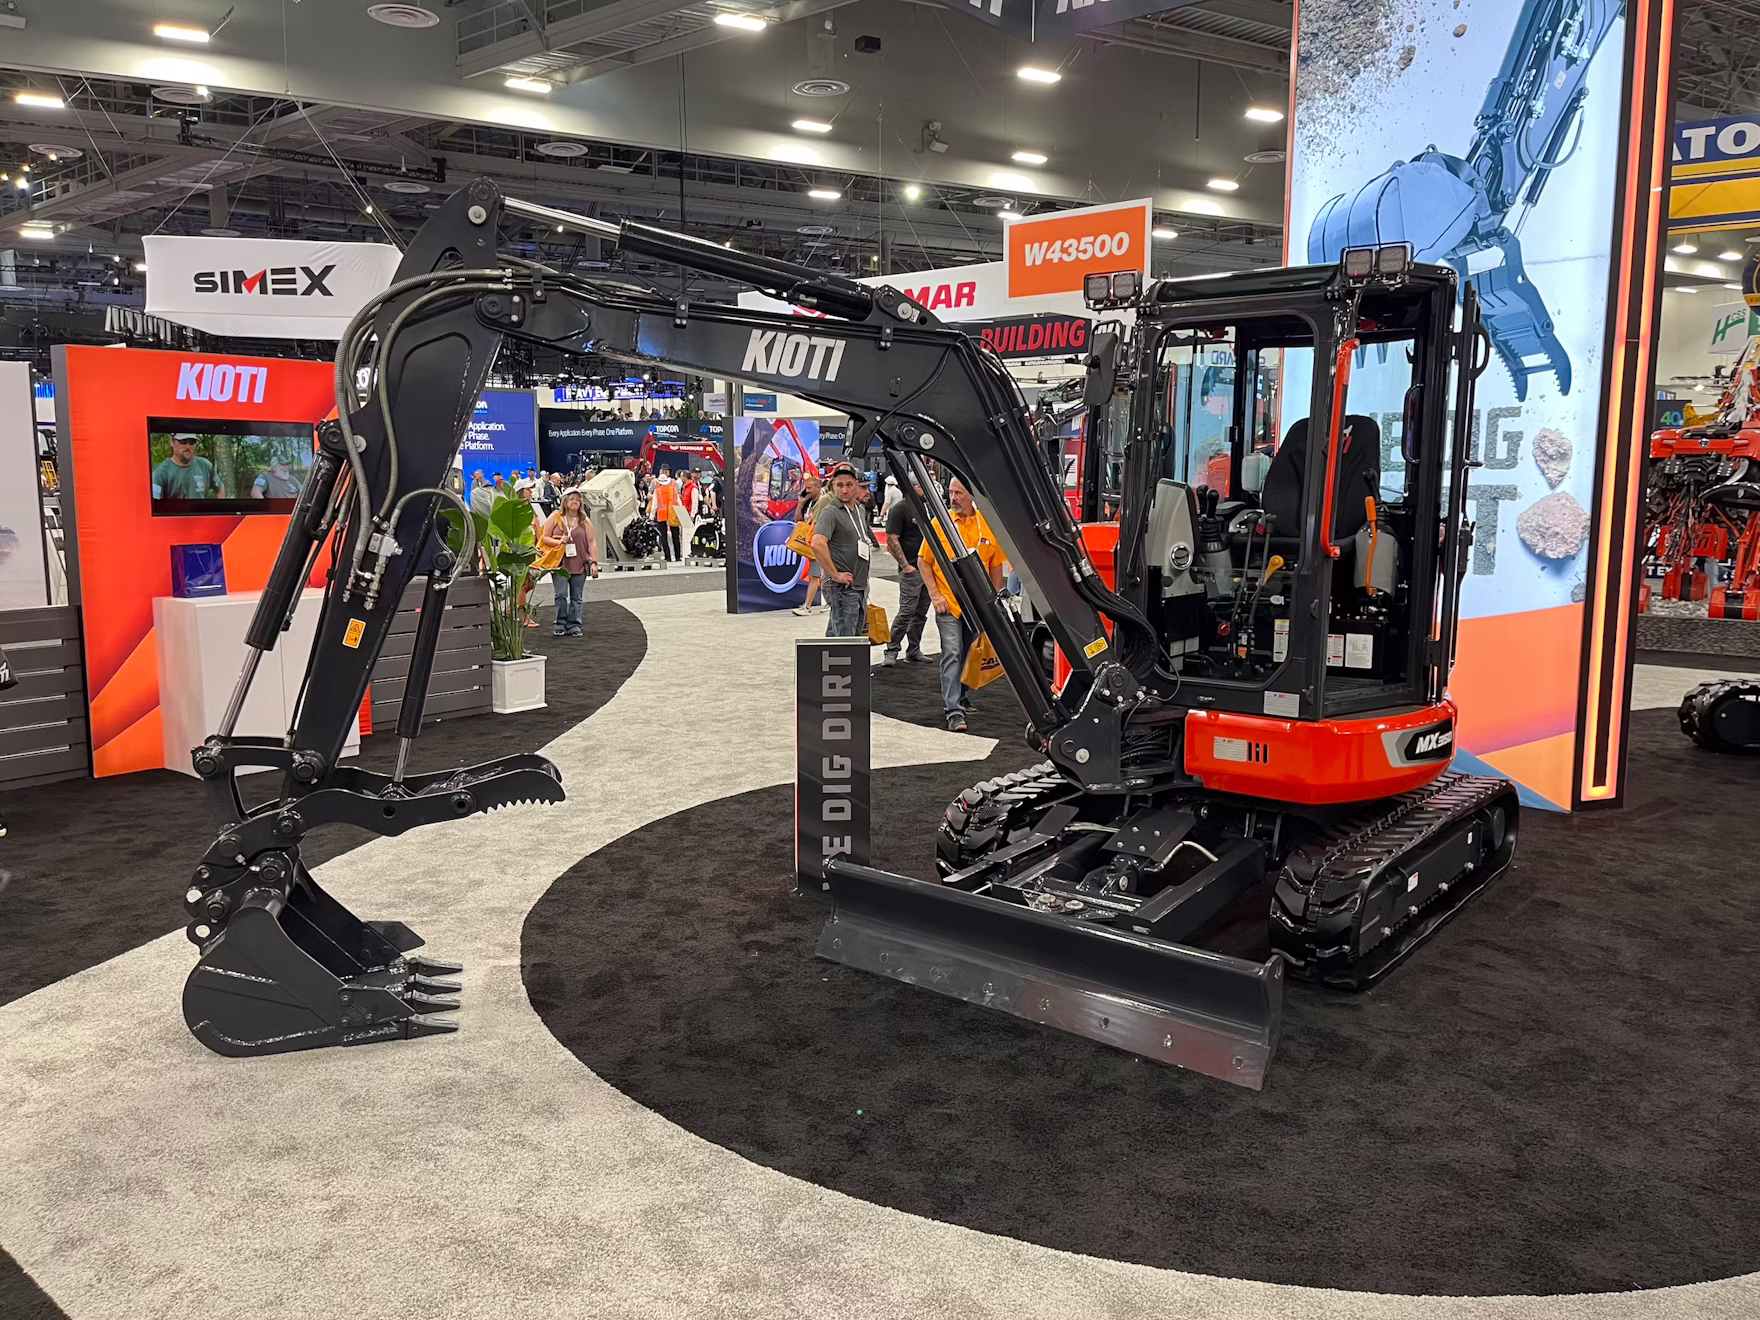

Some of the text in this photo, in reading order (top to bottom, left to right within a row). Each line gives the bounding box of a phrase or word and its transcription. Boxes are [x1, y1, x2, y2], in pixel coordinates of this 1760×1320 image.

[1023, 231, 1130, 267] W43500
[193, 264, 337, 297] SIMEX
[979, 319, 1086, 354] BUILDING
[741, 329, 847, 383] KIOTI
[176, 362, 268, 403] KIOTI
[656, 425, 679, 433] TOPCON
[822, 651, 852, 740] DIRT
[822, 755, 852, 821] DIG
